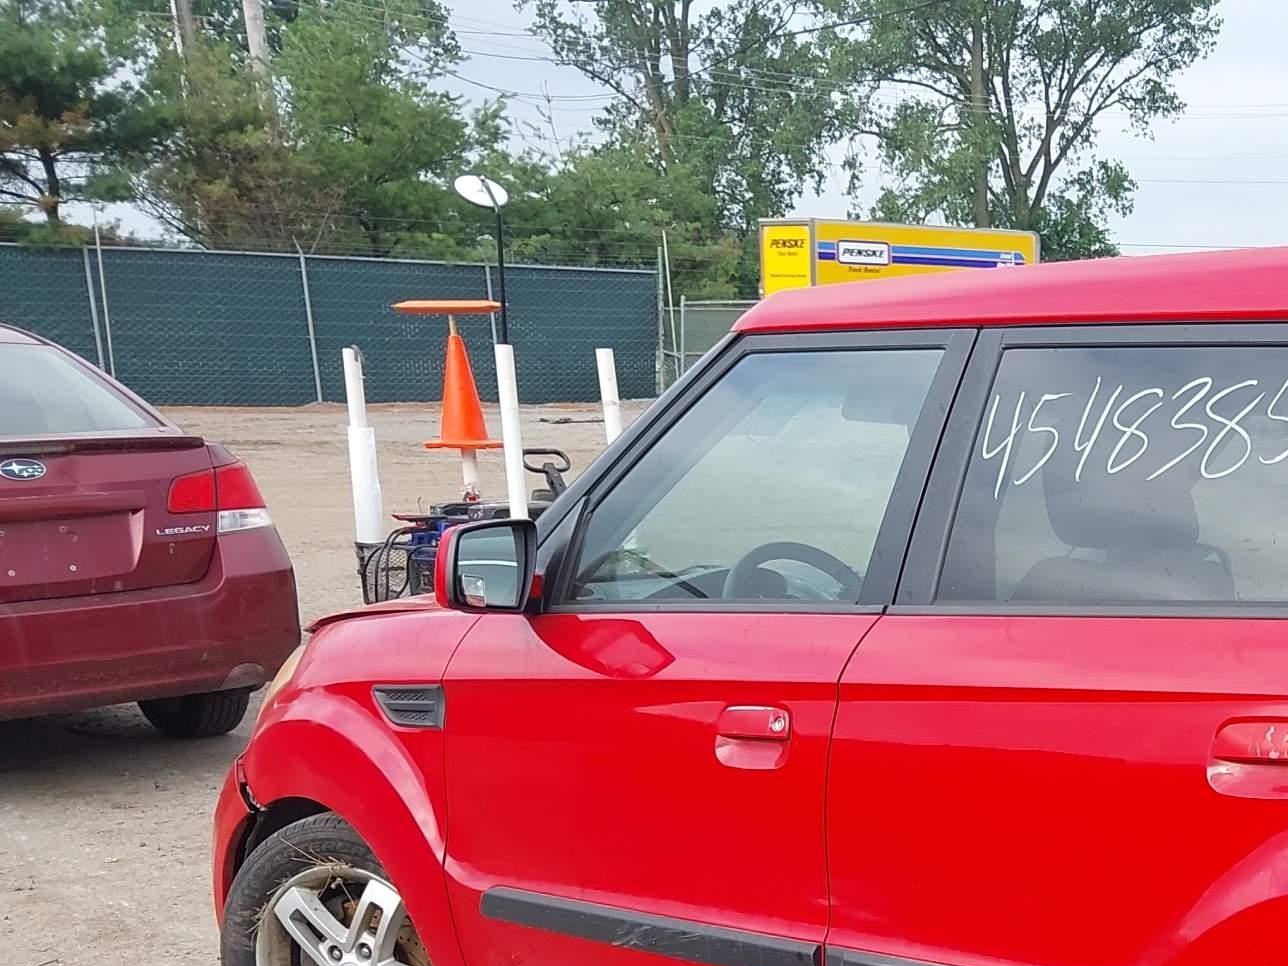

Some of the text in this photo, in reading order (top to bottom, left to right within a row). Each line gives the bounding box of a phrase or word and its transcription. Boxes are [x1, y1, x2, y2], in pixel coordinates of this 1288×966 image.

[770, 239, 805, 248] PENSKE
[842, 247, 885, 258] PENSKE
[156, 525, 210, 535] LEGACY
